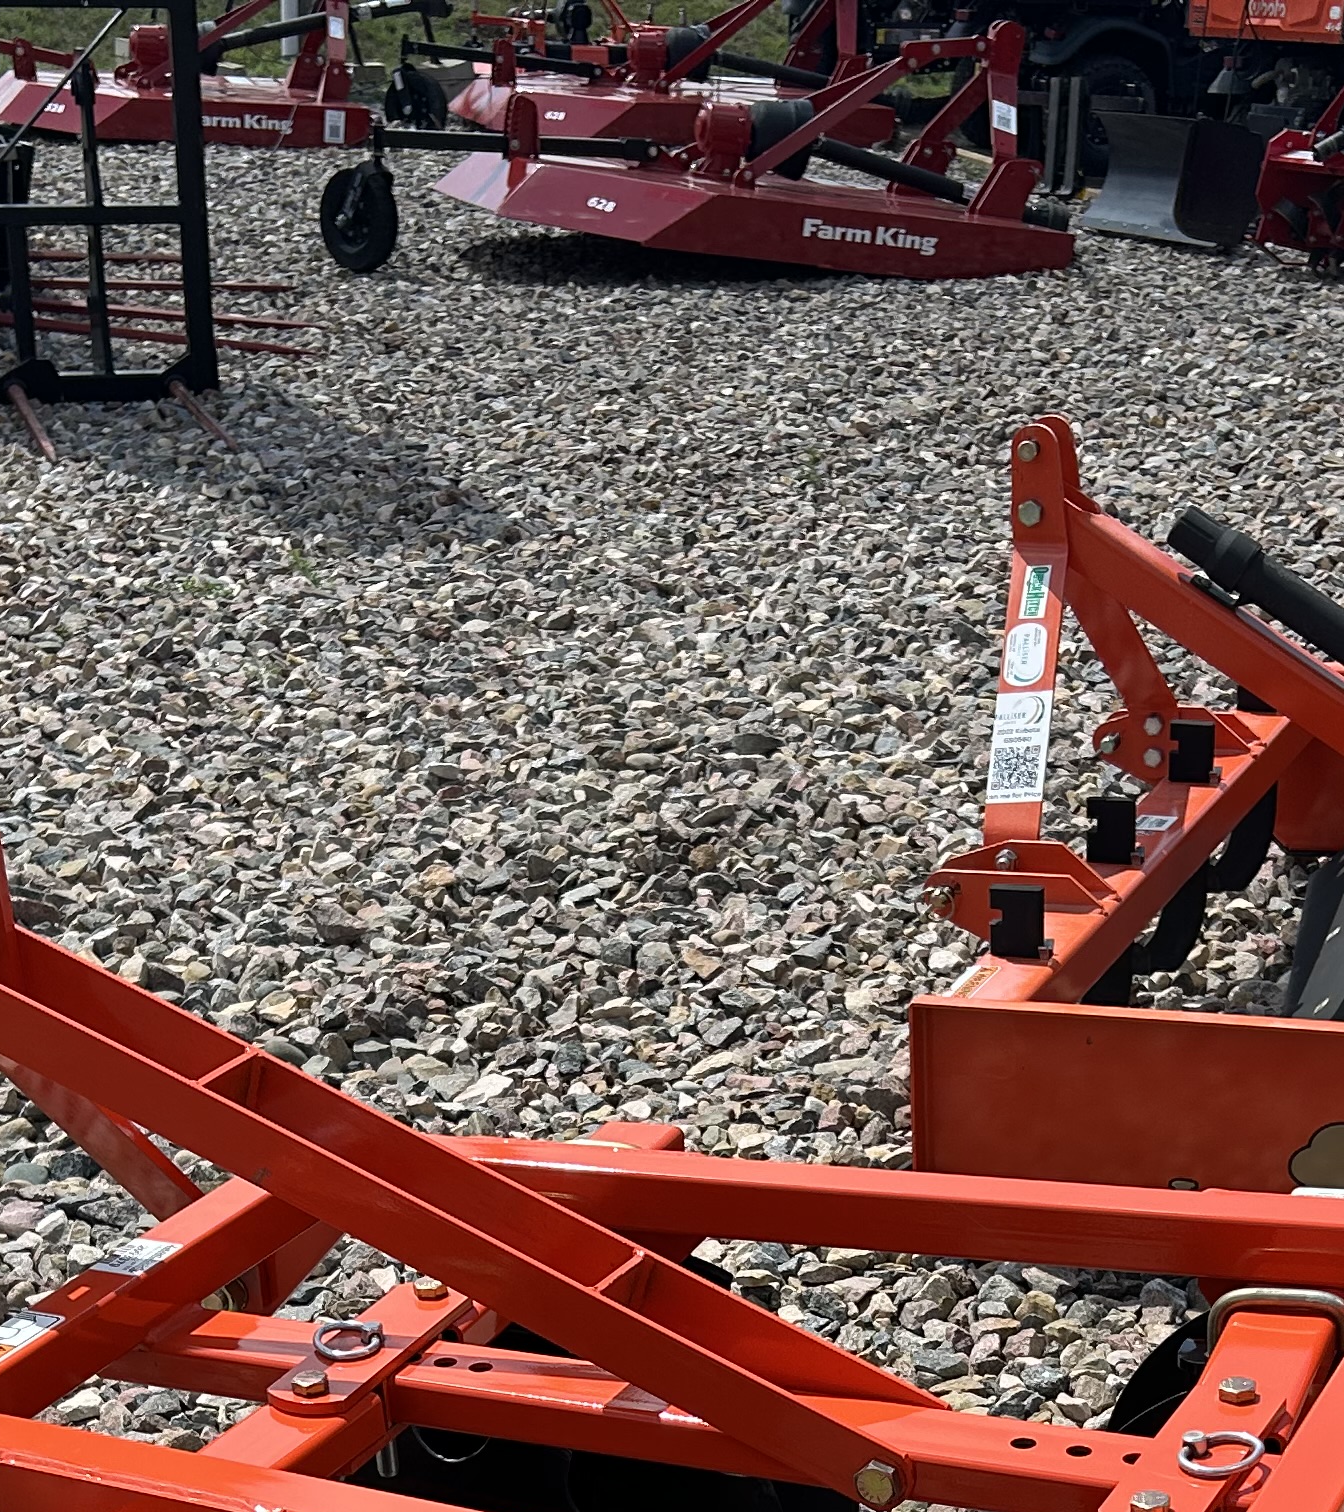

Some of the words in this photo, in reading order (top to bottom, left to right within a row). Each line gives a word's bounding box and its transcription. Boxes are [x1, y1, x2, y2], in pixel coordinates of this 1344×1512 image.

[201, 115, 242, 128] arm
[243, 113, 293, 134] King
[587, 196, 616, 213] 628
[802, 217, 872, 244] Farm
[874, 226, 939, 256] King
